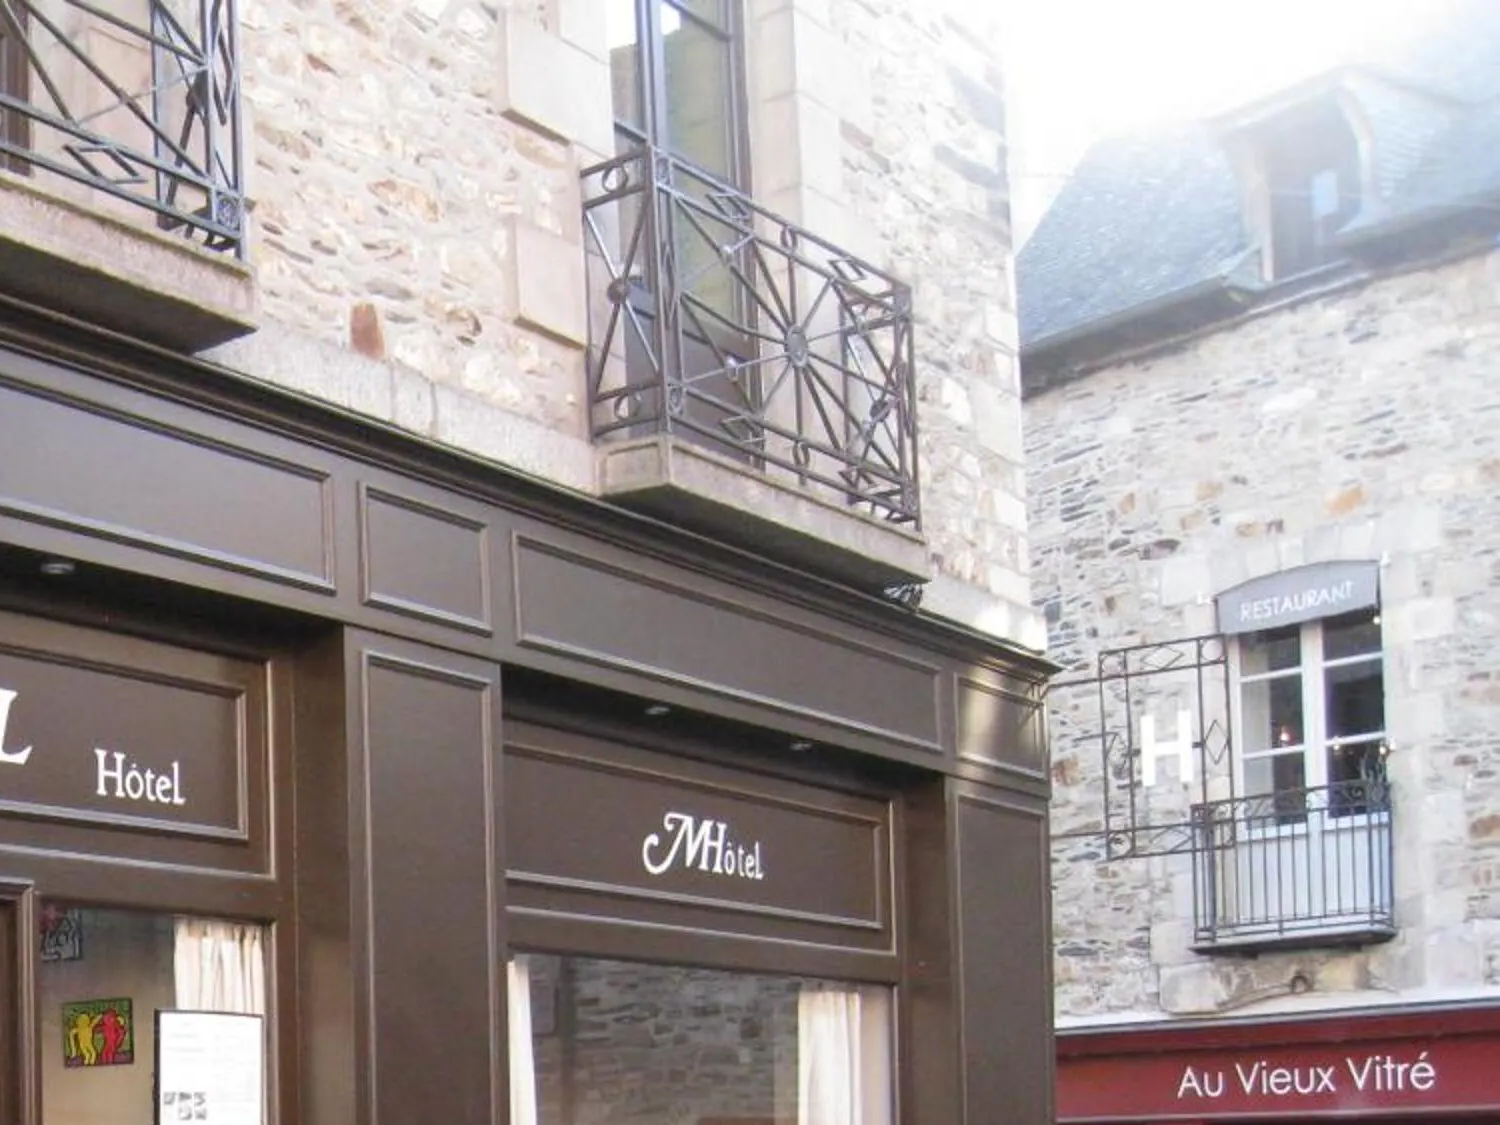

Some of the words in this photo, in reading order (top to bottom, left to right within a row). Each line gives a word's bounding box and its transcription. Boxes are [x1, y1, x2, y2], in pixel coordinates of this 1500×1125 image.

[1239, 579, 1354, 622] RESTAURANT
[93, 748, 186, 806] Hôtel
[1177, 1065, 1225, 1099] Au
[1235, 1060, 1337, 1096] Vieux
[1346, 1051, 1437, 1092] Vitré
